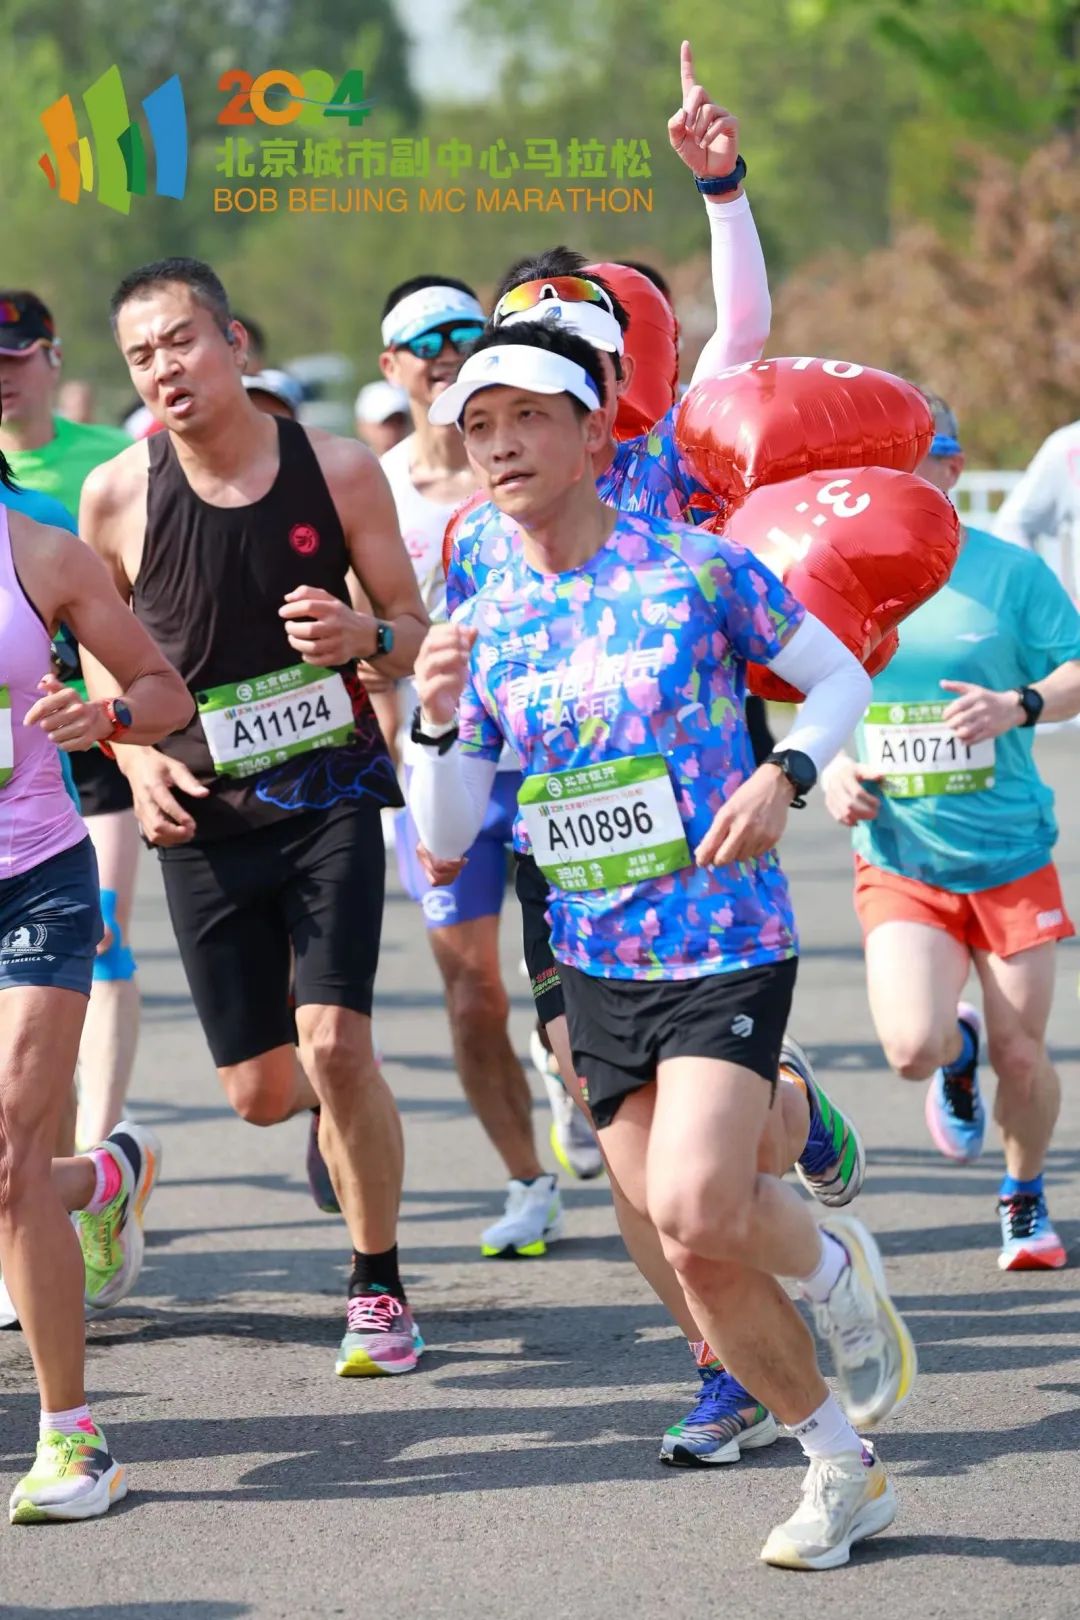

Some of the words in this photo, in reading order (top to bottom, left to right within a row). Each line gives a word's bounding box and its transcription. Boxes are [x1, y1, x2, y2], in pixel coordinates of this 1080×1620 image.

[233, 694, 331, 748] A11124
[541, 694, 620, 730] PACER
[548, 801, 654, 851] A10896
